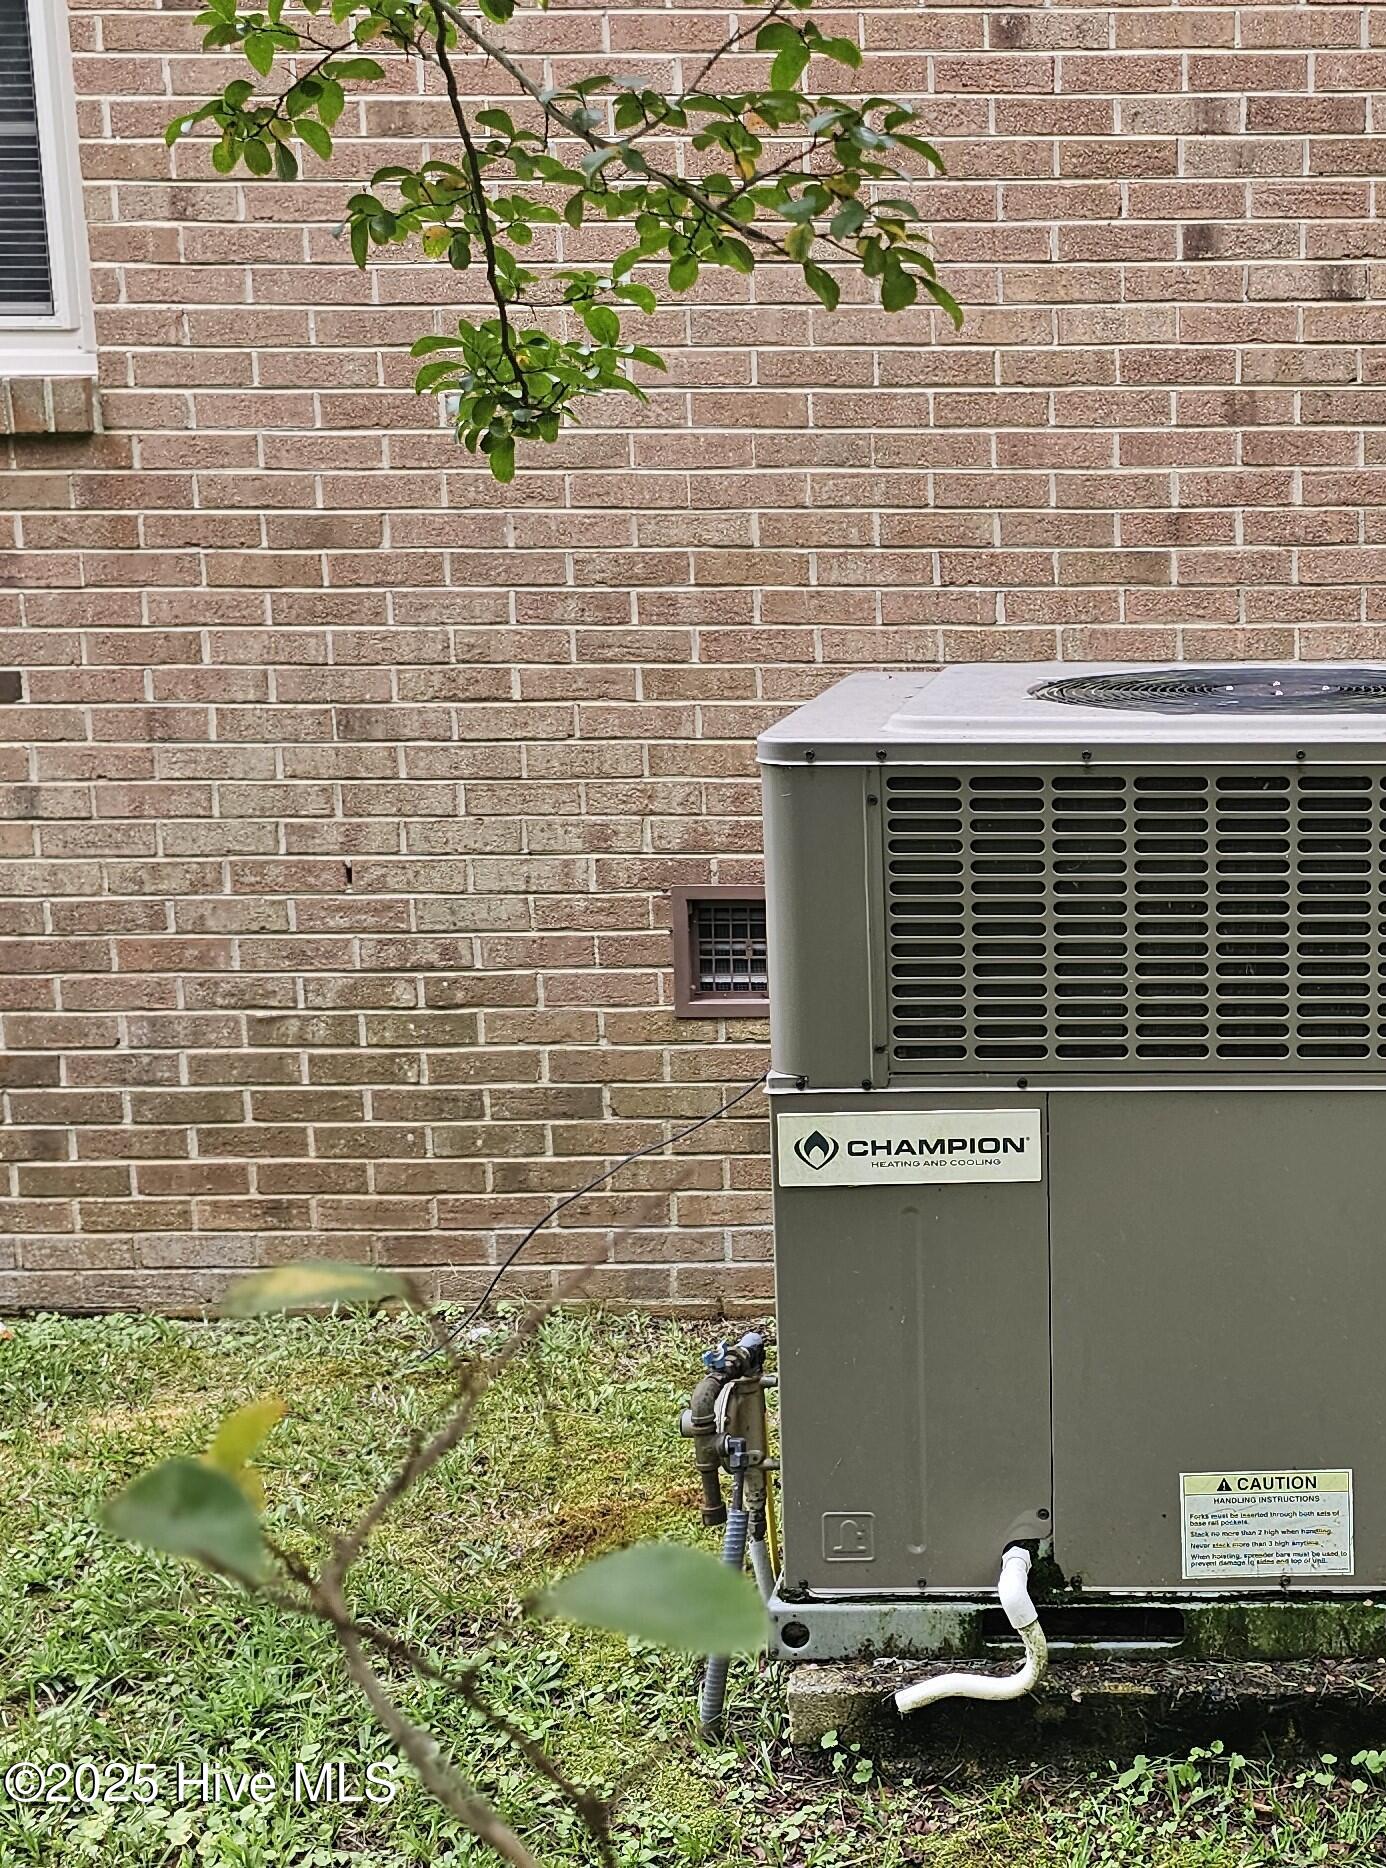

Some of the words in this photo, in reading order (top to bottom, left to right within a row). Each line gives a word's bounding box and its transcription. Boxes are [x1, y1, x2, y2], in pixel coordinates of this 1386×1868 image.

[871, 1160, 921, 1168] HEATING
[923, 1159, 947, 1167] AND
[950, 1158, 1001, 1166] COOLING
[1237, 1475, 1317, 1491] CAUTION
[1213, 1496, 1257, 1504] HANDLING
[1258, 1495, 1320, 1504] INSTRUCTIONS
